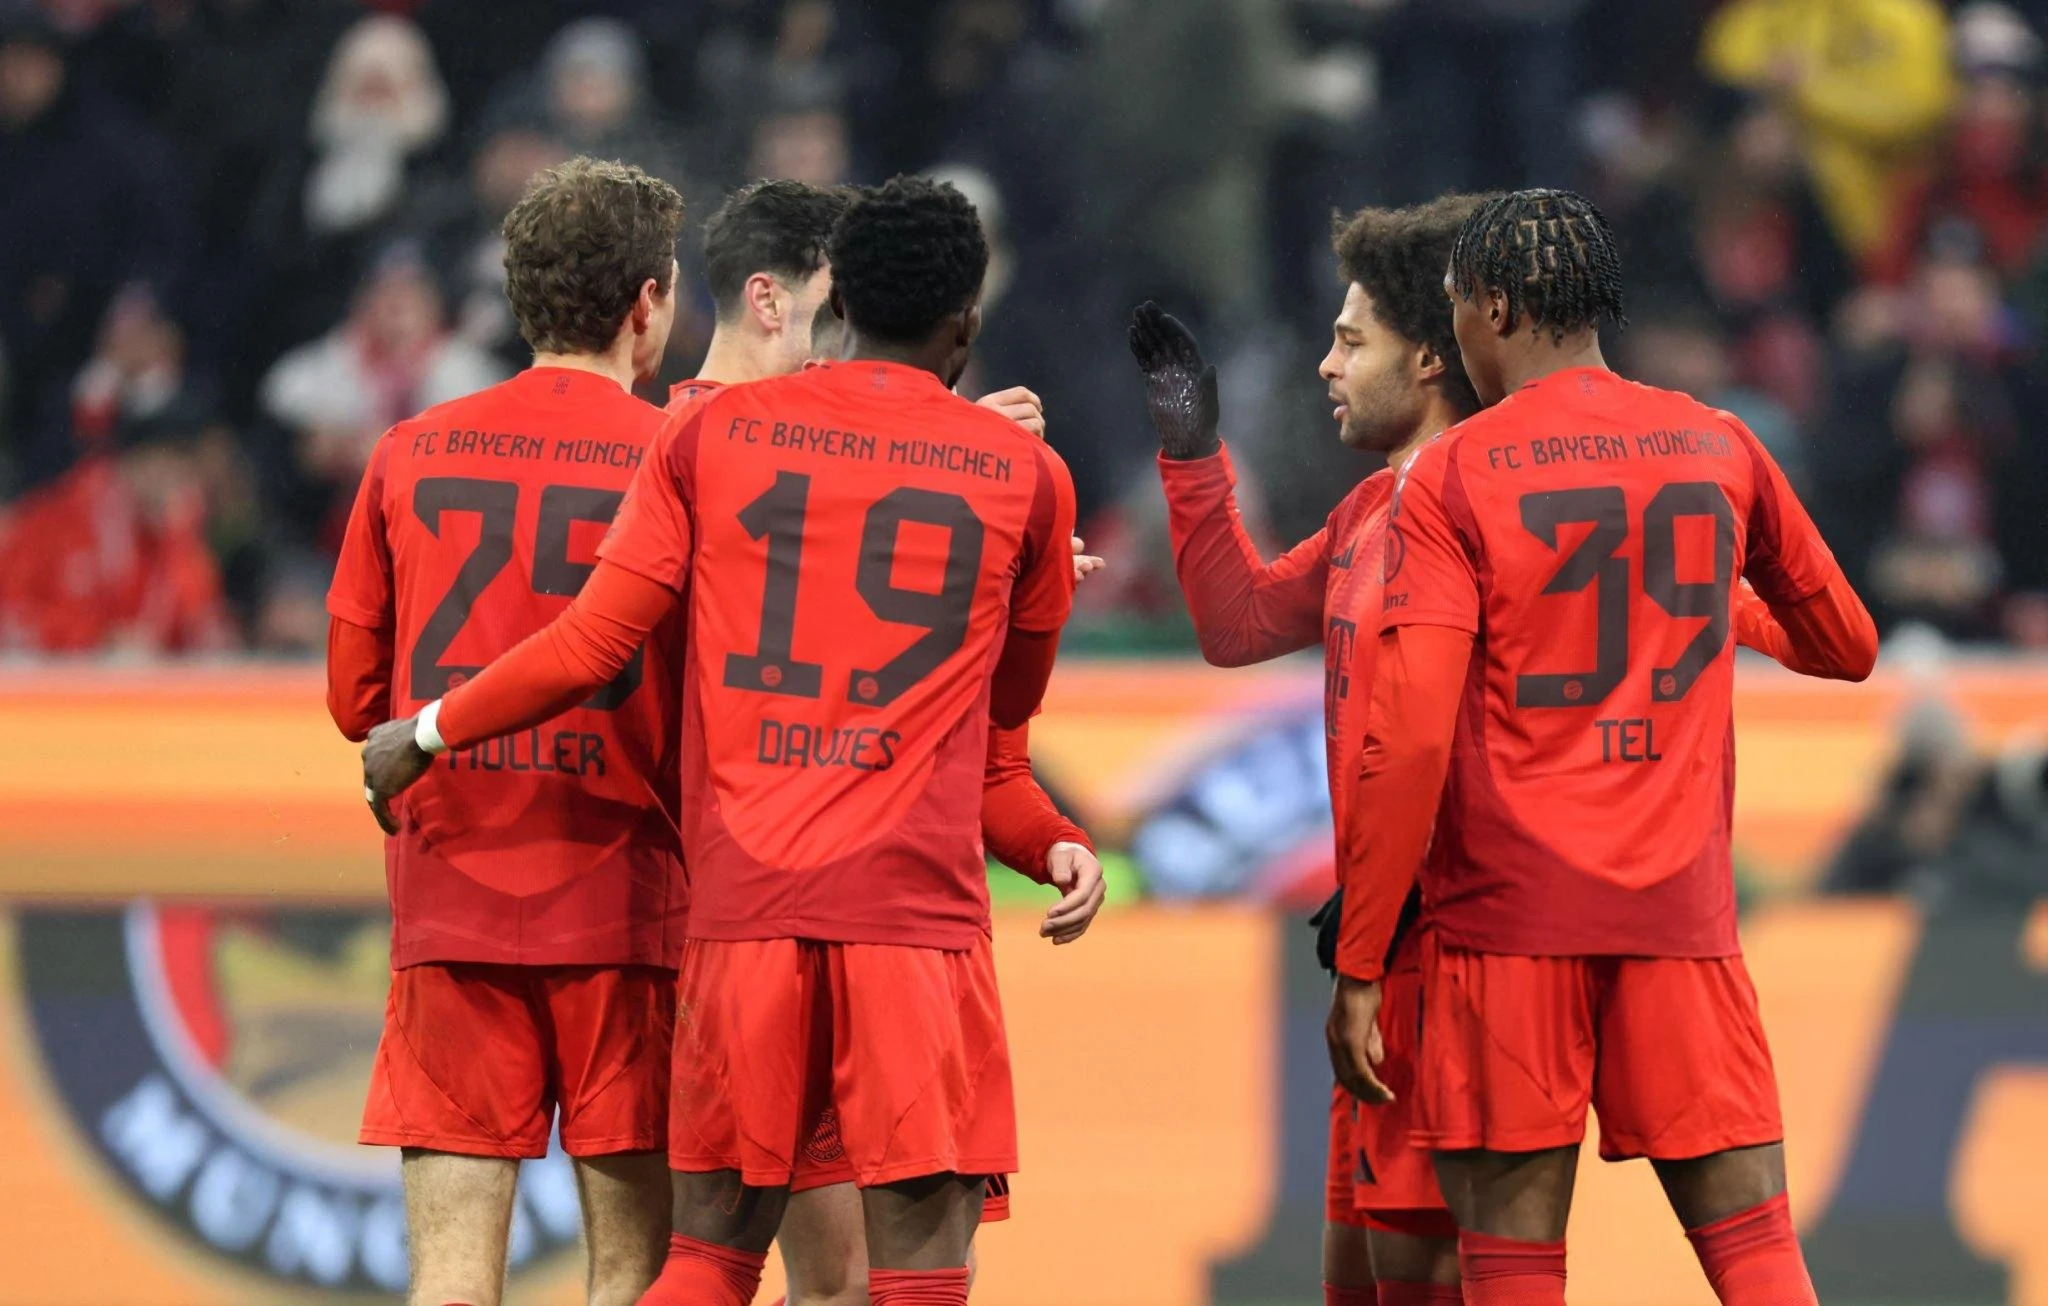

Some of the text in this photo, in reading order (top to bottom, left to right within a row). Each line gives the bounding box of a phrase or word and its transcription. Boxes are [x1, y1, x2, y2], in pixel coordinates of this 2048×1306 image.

[412, 430, 644, 470] FC BAYERN MÜNCH
[728, 418, 1011, 482] FC BAYERN MÜNCHEN
[1487, 429, 1732, 470] FC BAYERN MÜNCHEN
[410, 477, 645, 711] 25
[723, 469, 985, 708] 19
[1516, 481, 1736, 708] 39
[758, 719, 900, 771] DAVIES
[1594, 719, 1662, 762] TEL
